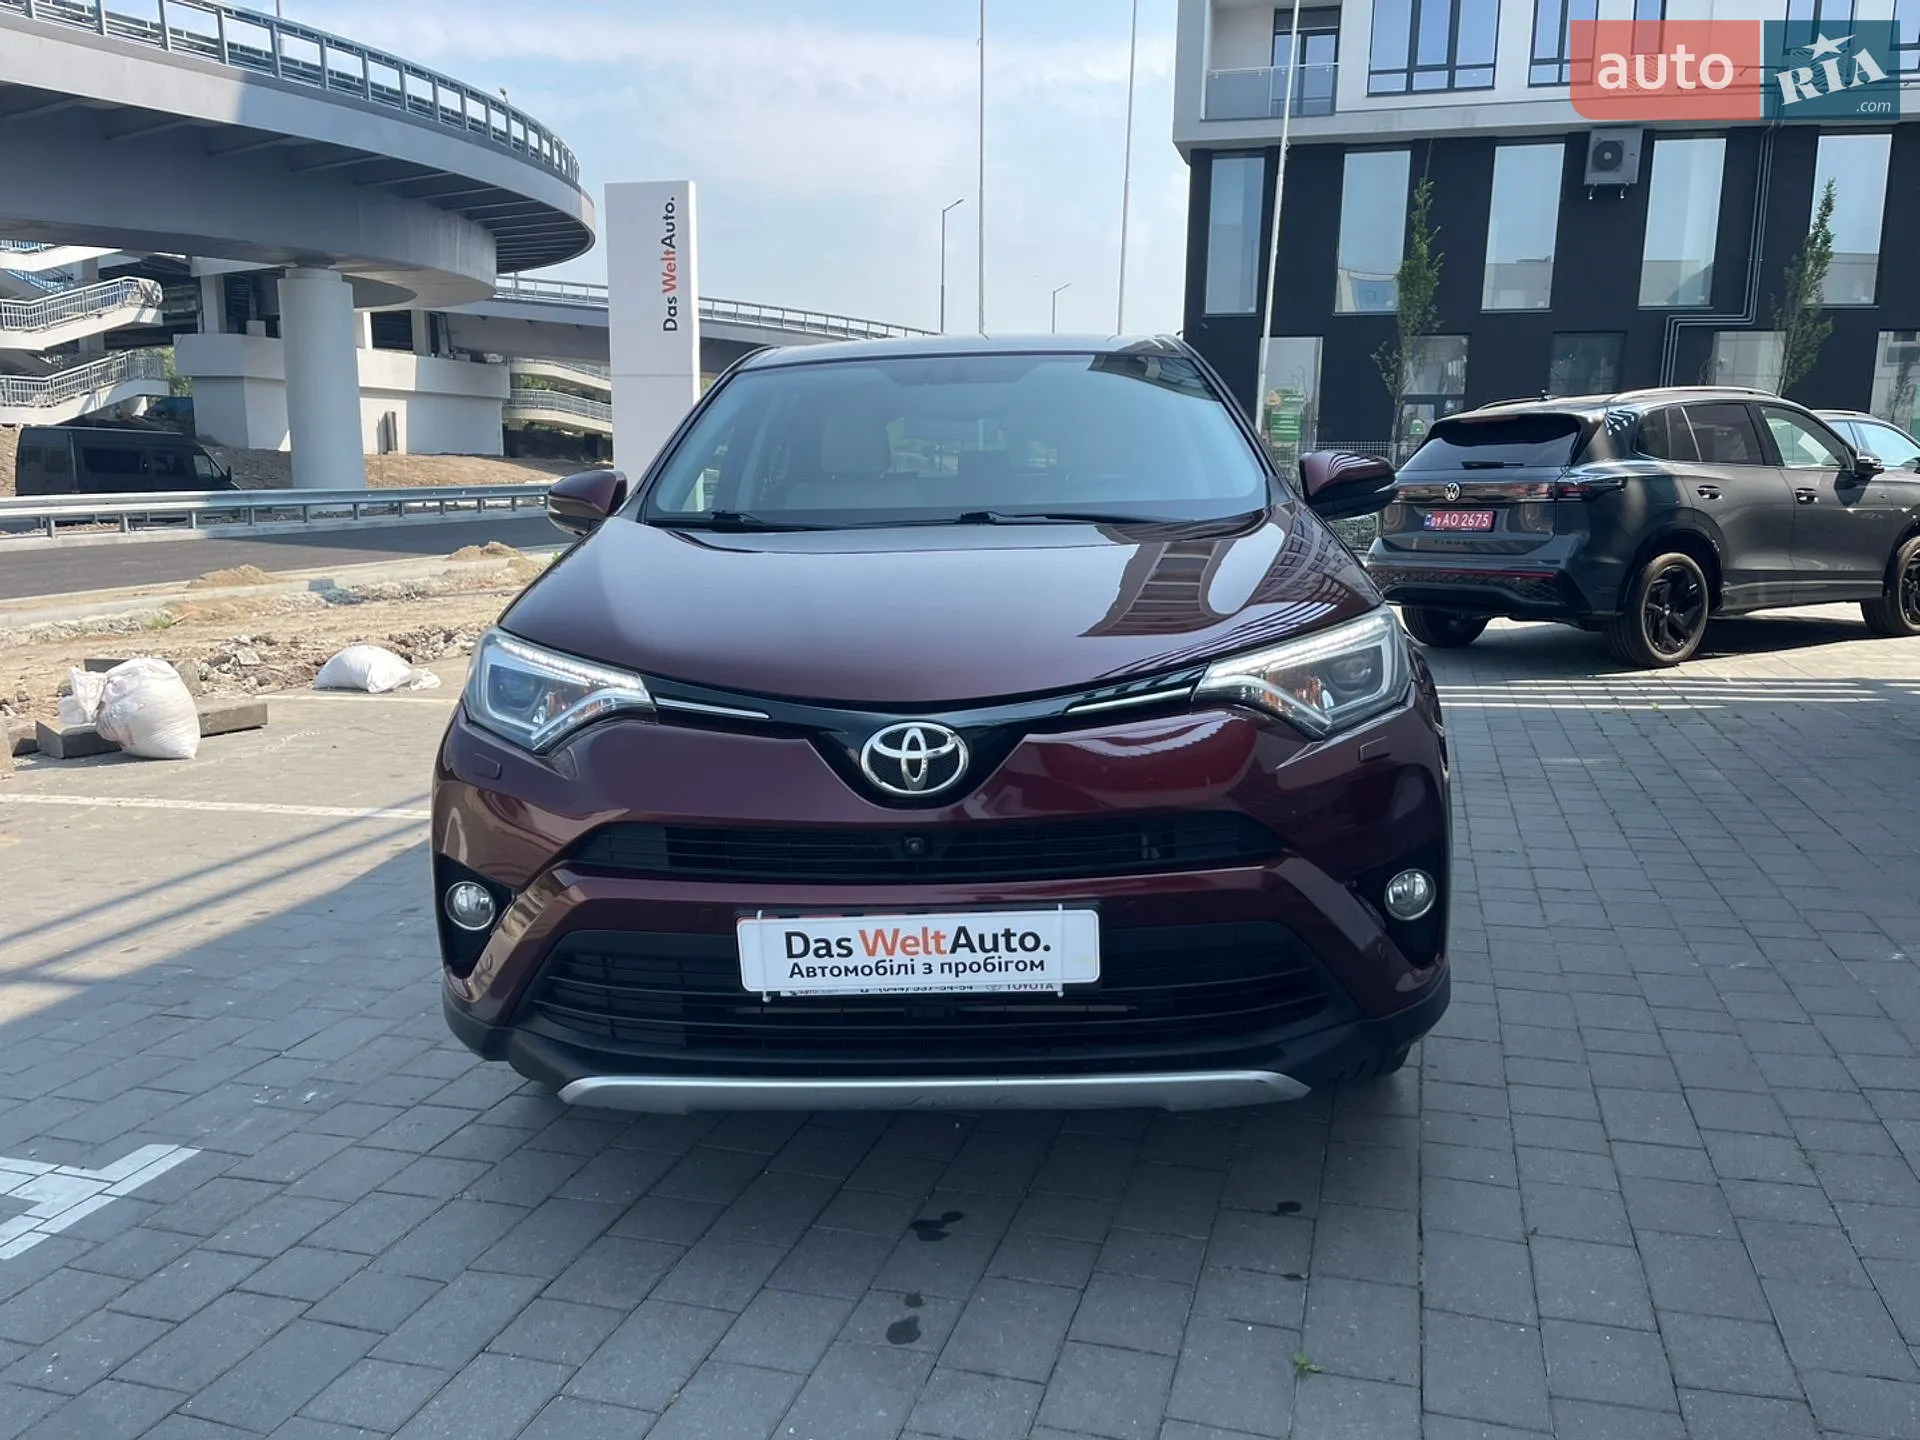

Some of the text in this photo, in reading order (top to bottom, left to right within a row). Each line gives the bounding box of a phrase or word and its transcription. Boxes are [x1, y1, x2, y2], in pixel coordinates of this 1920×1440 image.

[663, 296, 678, 331] Das
[1461, 513, 1489, 527] 2675
[784, 930, 854, 960] Das
[789, 956, 1045, 979] Автомобілі з пробігом
